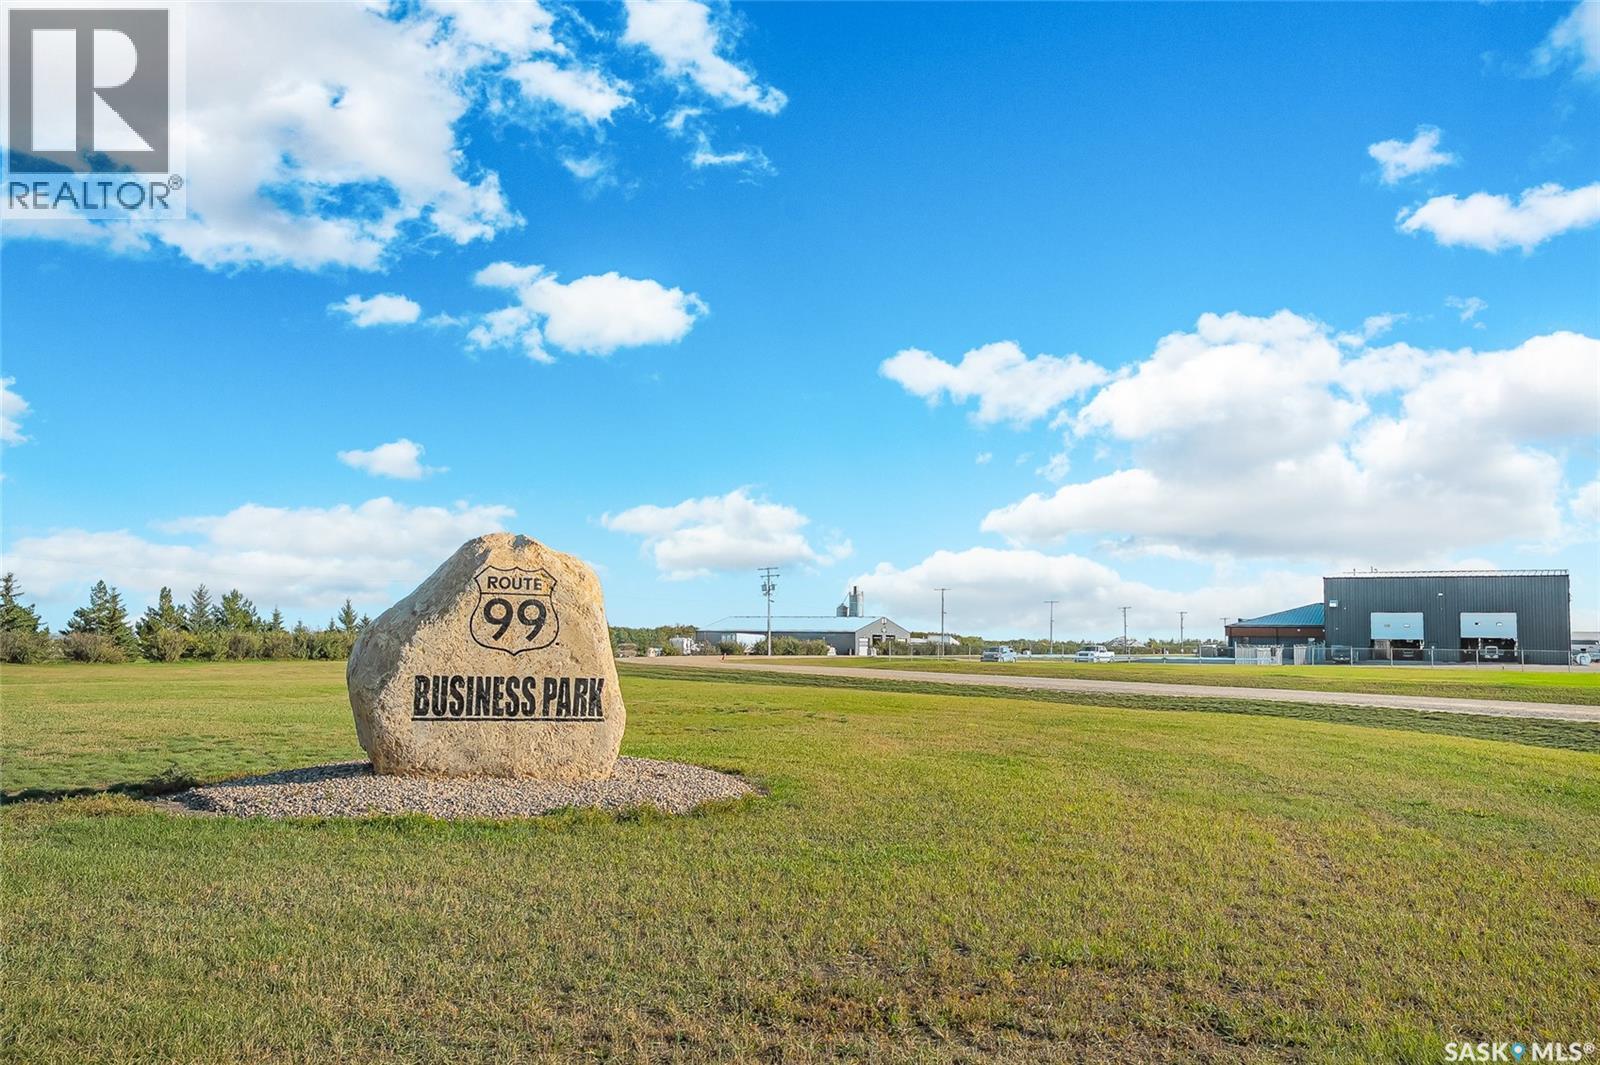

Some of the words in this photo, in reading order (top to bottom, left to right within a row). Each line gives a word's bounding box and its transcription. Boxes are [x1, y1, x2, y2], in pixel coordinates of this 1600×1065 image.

[487, 576, 542, 592] ROUTE
[483, 598, 547, 642] 99
[414, 674, 536, 718] BUSINESS
[542, 677, 605, 718] PARK
